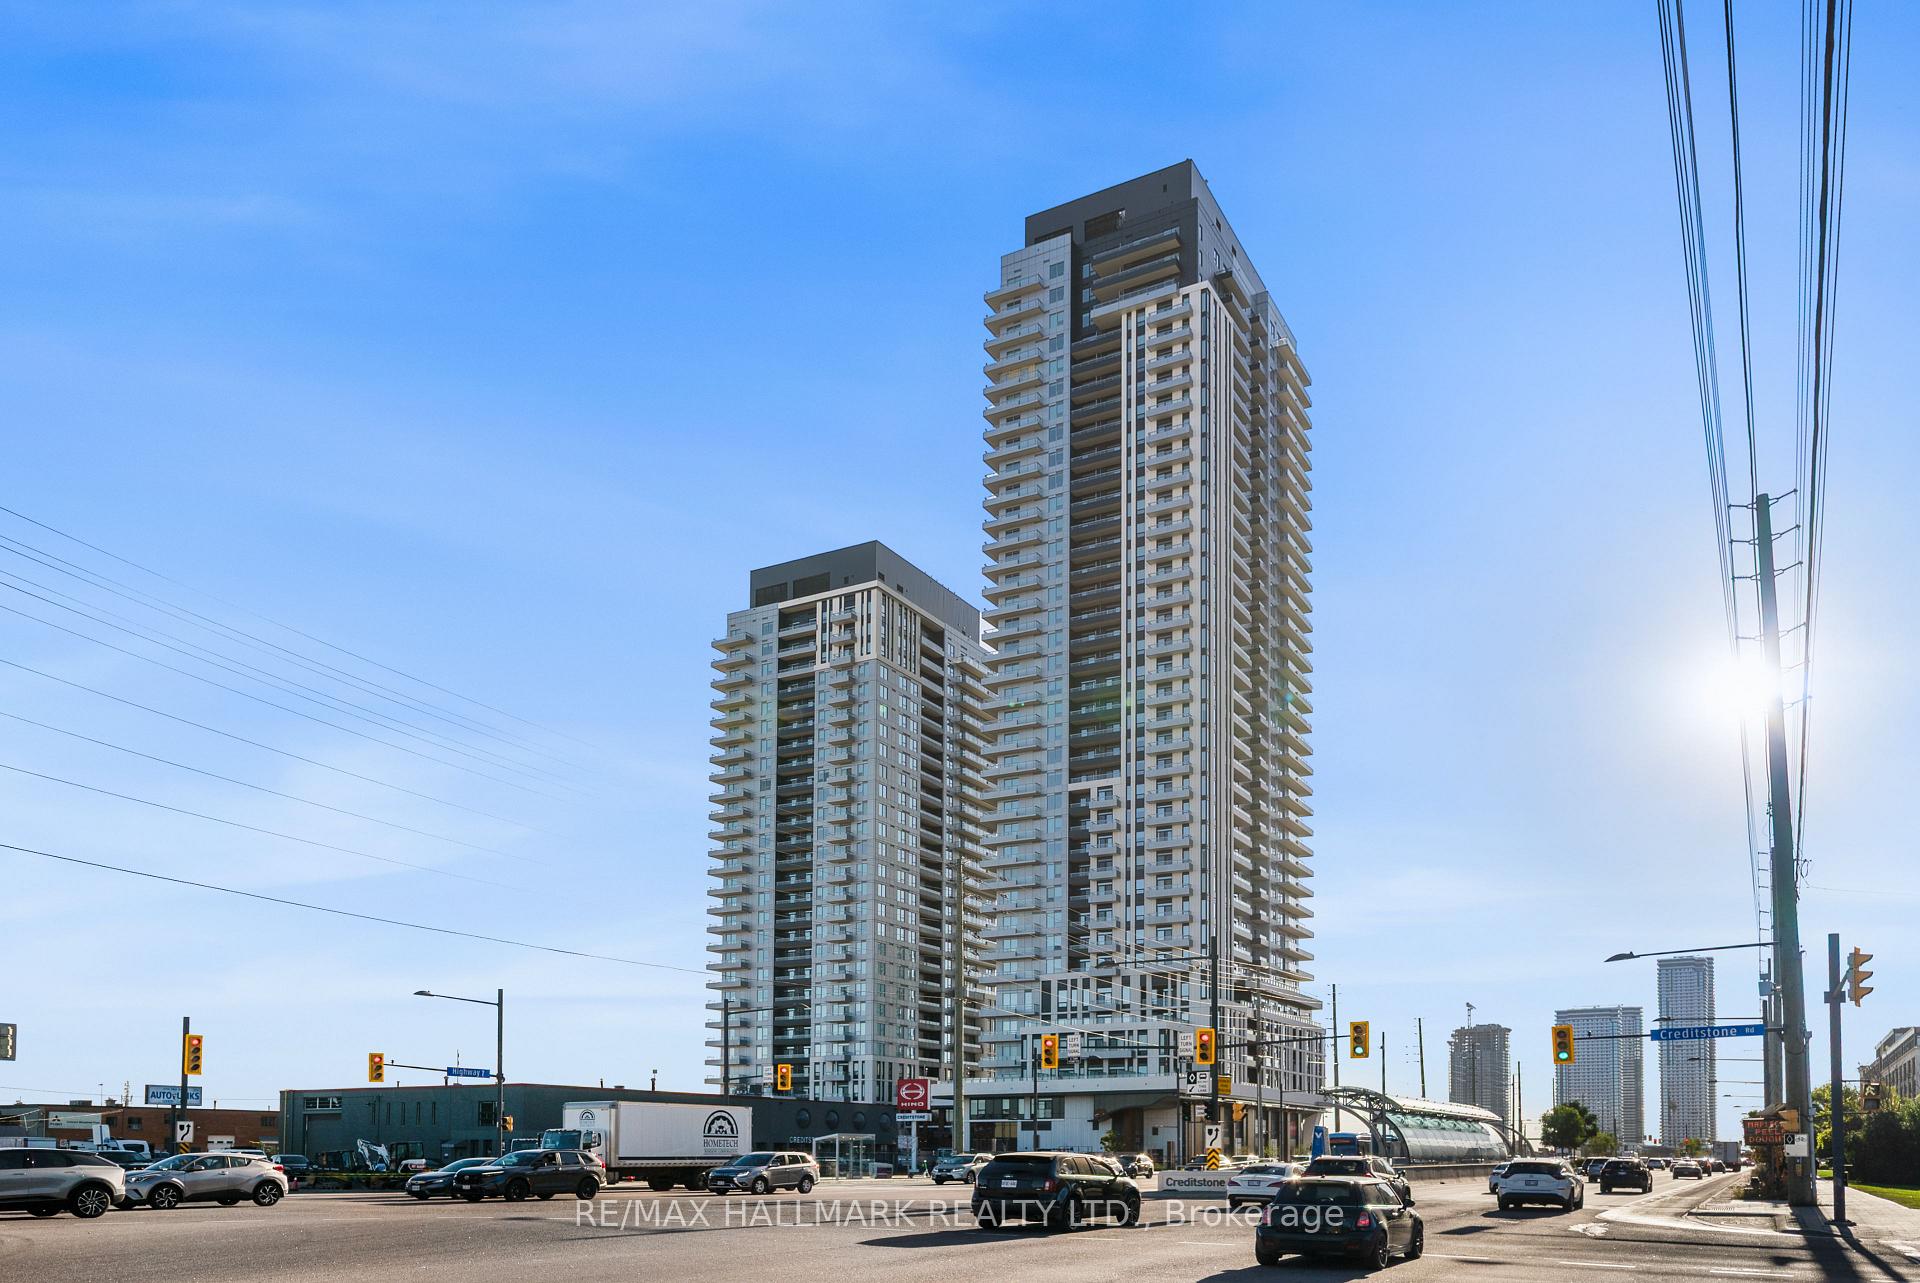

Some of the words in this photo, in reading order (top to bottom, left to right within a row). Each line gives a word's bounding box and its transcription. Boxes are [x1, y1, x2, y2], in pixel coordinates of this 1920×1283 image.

[1660, 1027, 1737, 1039] Creditstone
[452, 1068, 480, 1077] Highway
[150, 1091, 171, 1099] AUTO
[703, 1139, 738, 1147] HOMETECH
[1166, 1177, 1226, 1187] Creditstone
